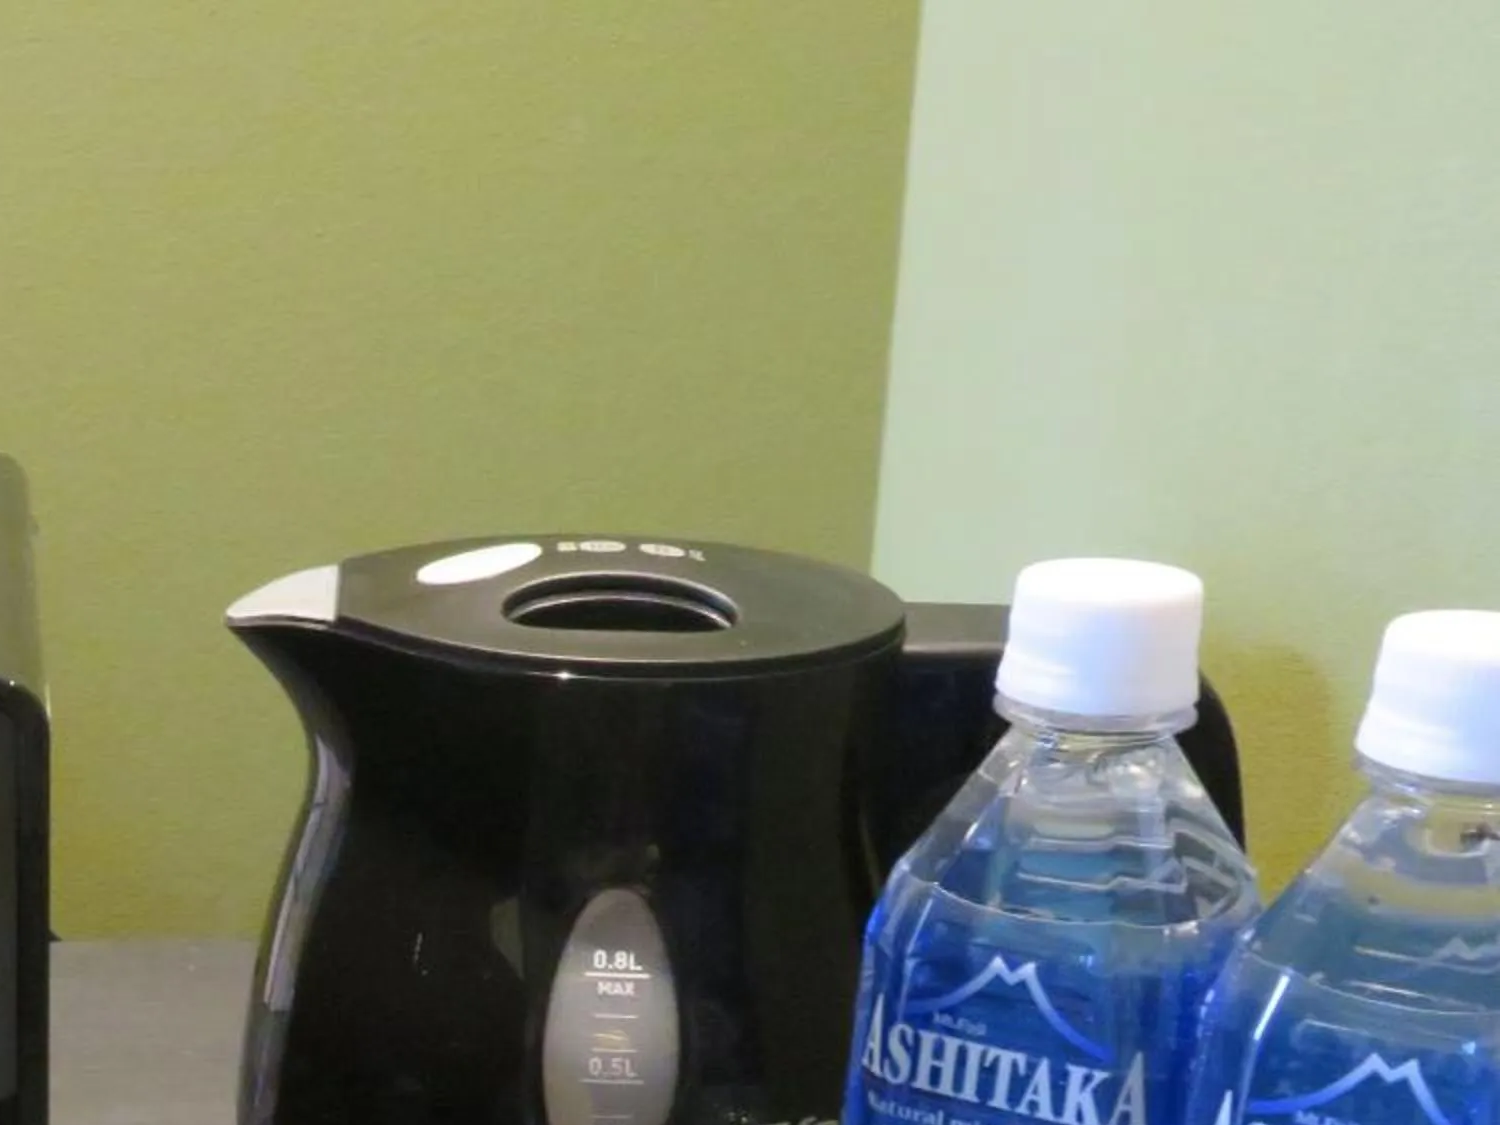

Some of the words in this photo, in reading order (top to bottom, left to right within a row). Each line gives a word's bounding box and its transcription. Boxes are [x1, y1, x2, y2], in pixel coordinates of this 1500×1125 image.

[593, 950, 643, 971] 0.8L
[598, 981, 636, 996] MAX
[588, 1057, 638, 1078] 0.5L
